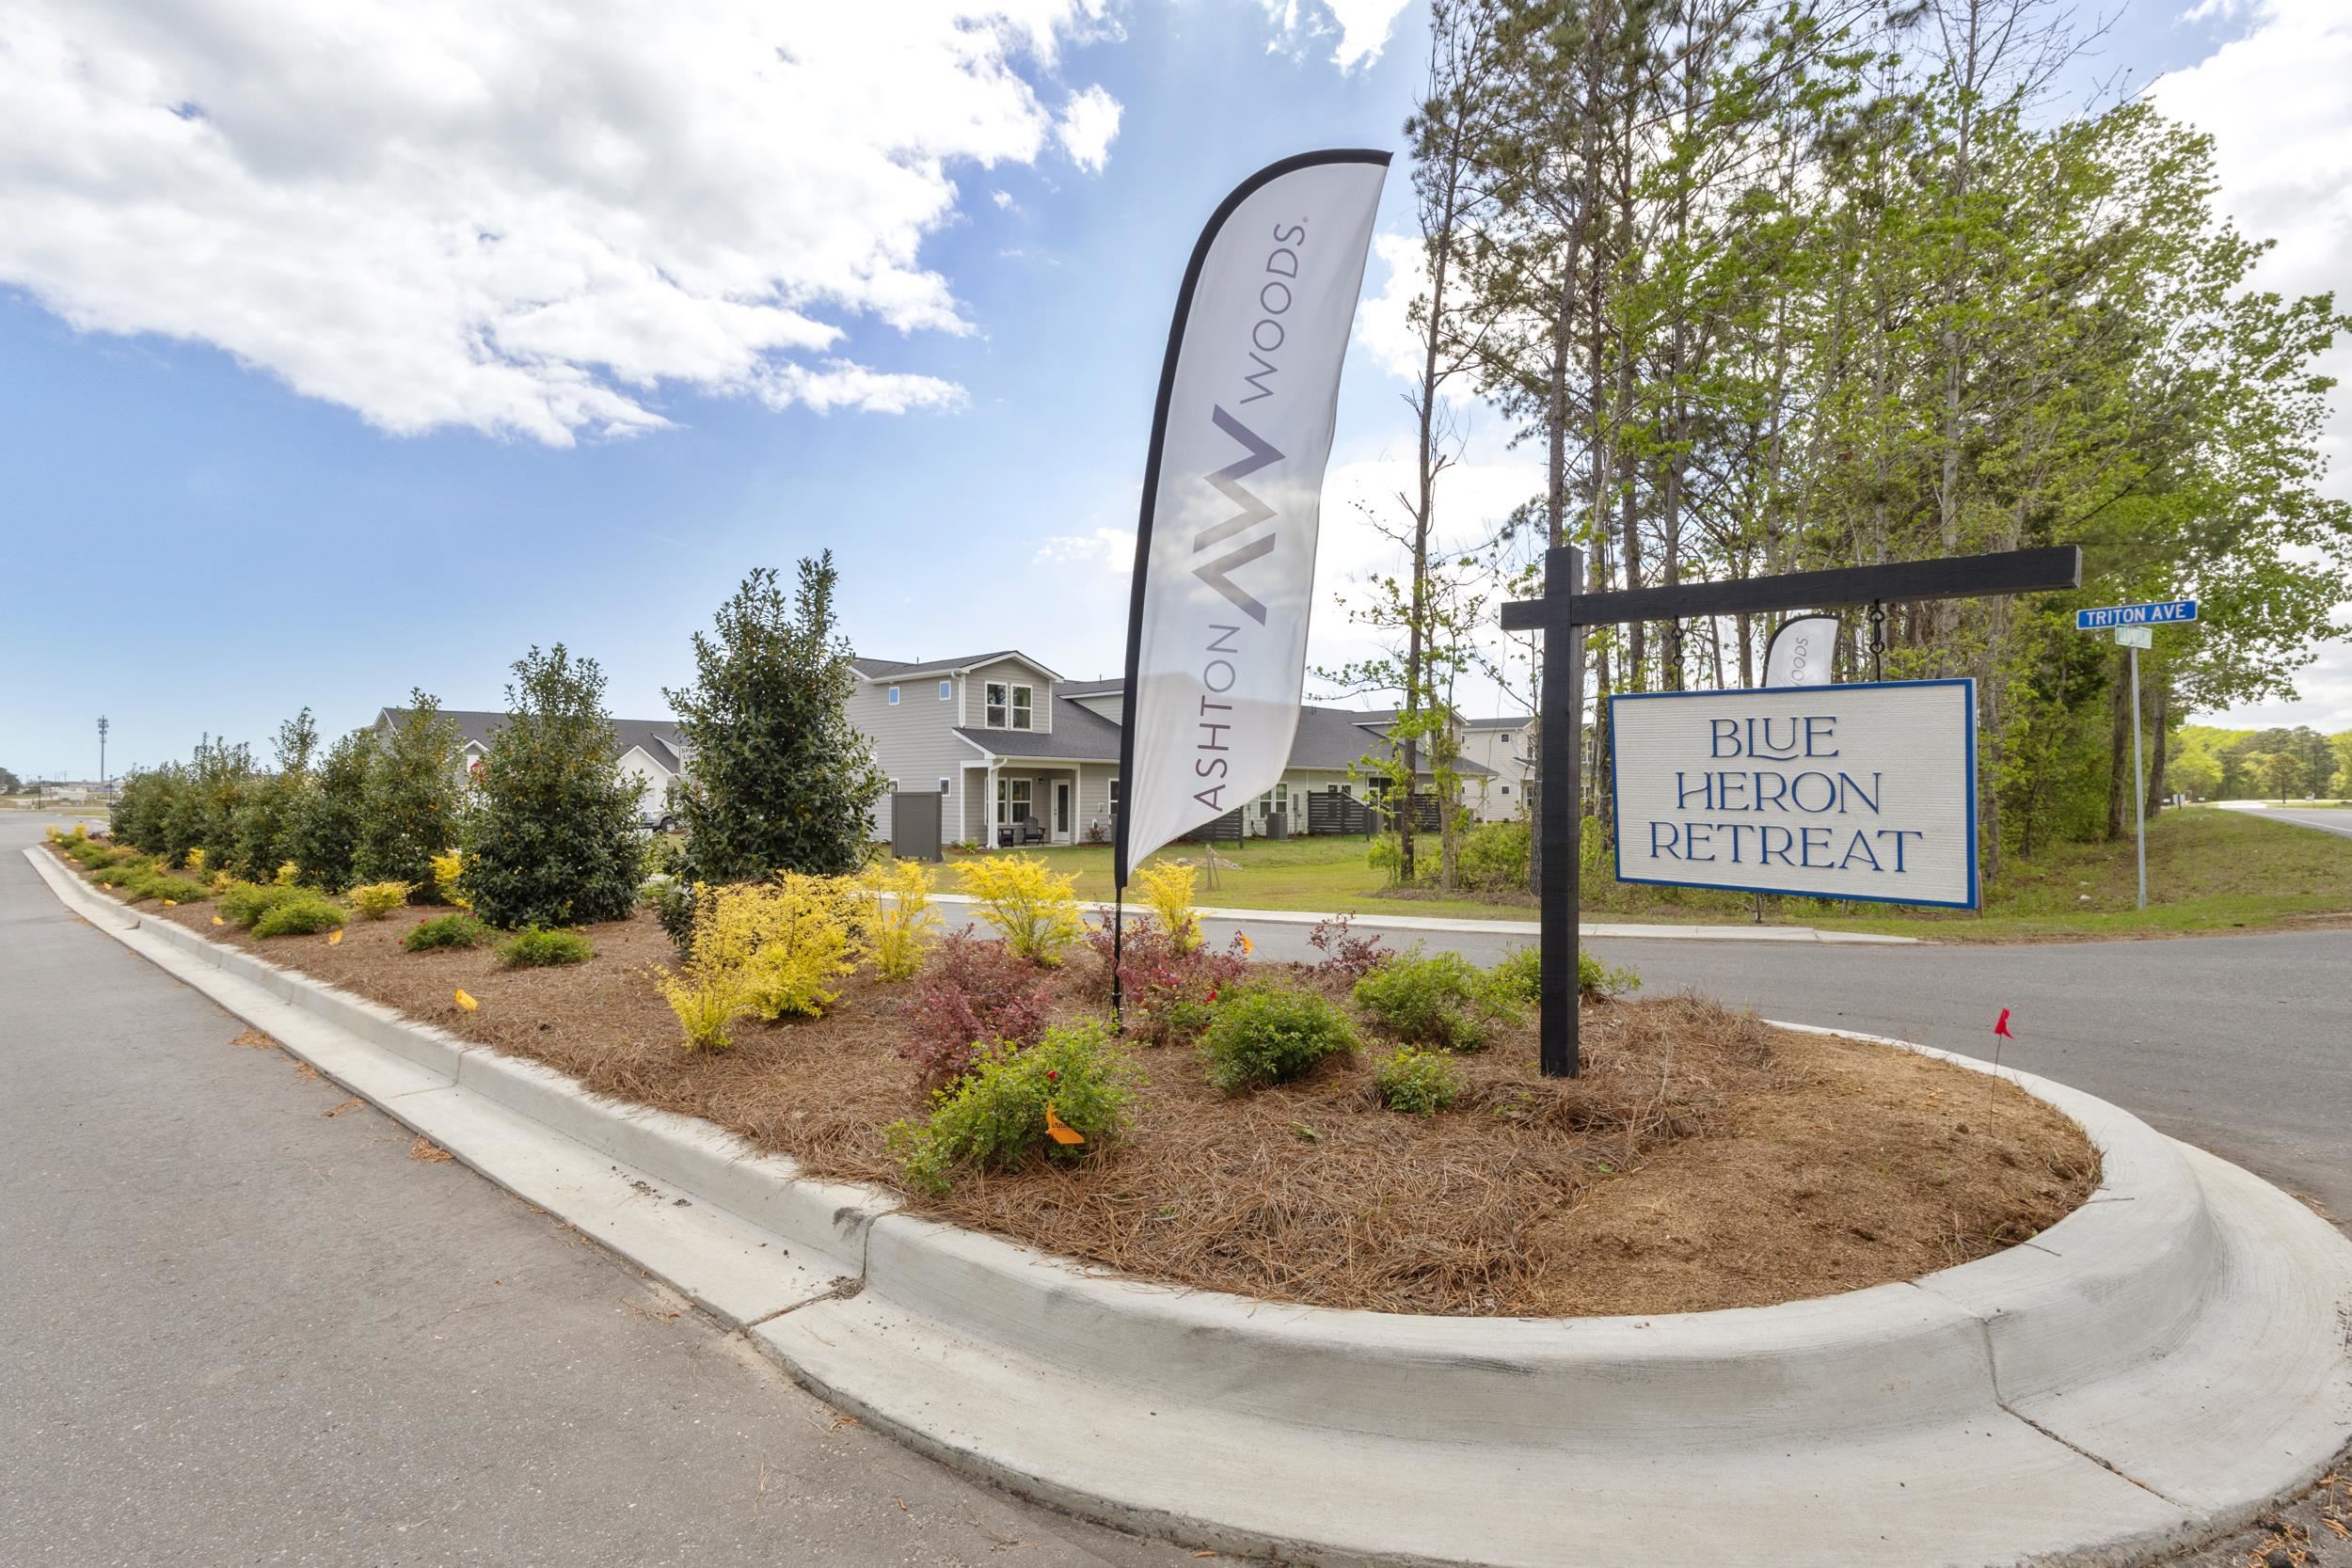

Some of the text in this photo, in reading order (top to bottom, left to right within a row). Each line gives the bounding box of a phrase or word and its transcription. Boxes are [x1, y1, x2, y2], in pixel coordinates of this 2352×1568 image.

[1193, 625, 1241, 812] ASHTON
[1240, 223, 1306, 404] WOODS
[2087, 603, 2185, 626] TRITON AVE
[1791, 637, 1808, 687] OODS
[1709, 716, 1839, 761] BLUE
[1676, 771, 1883, 815] HERON
[1649, 821, 1923, 873] RETREAT
